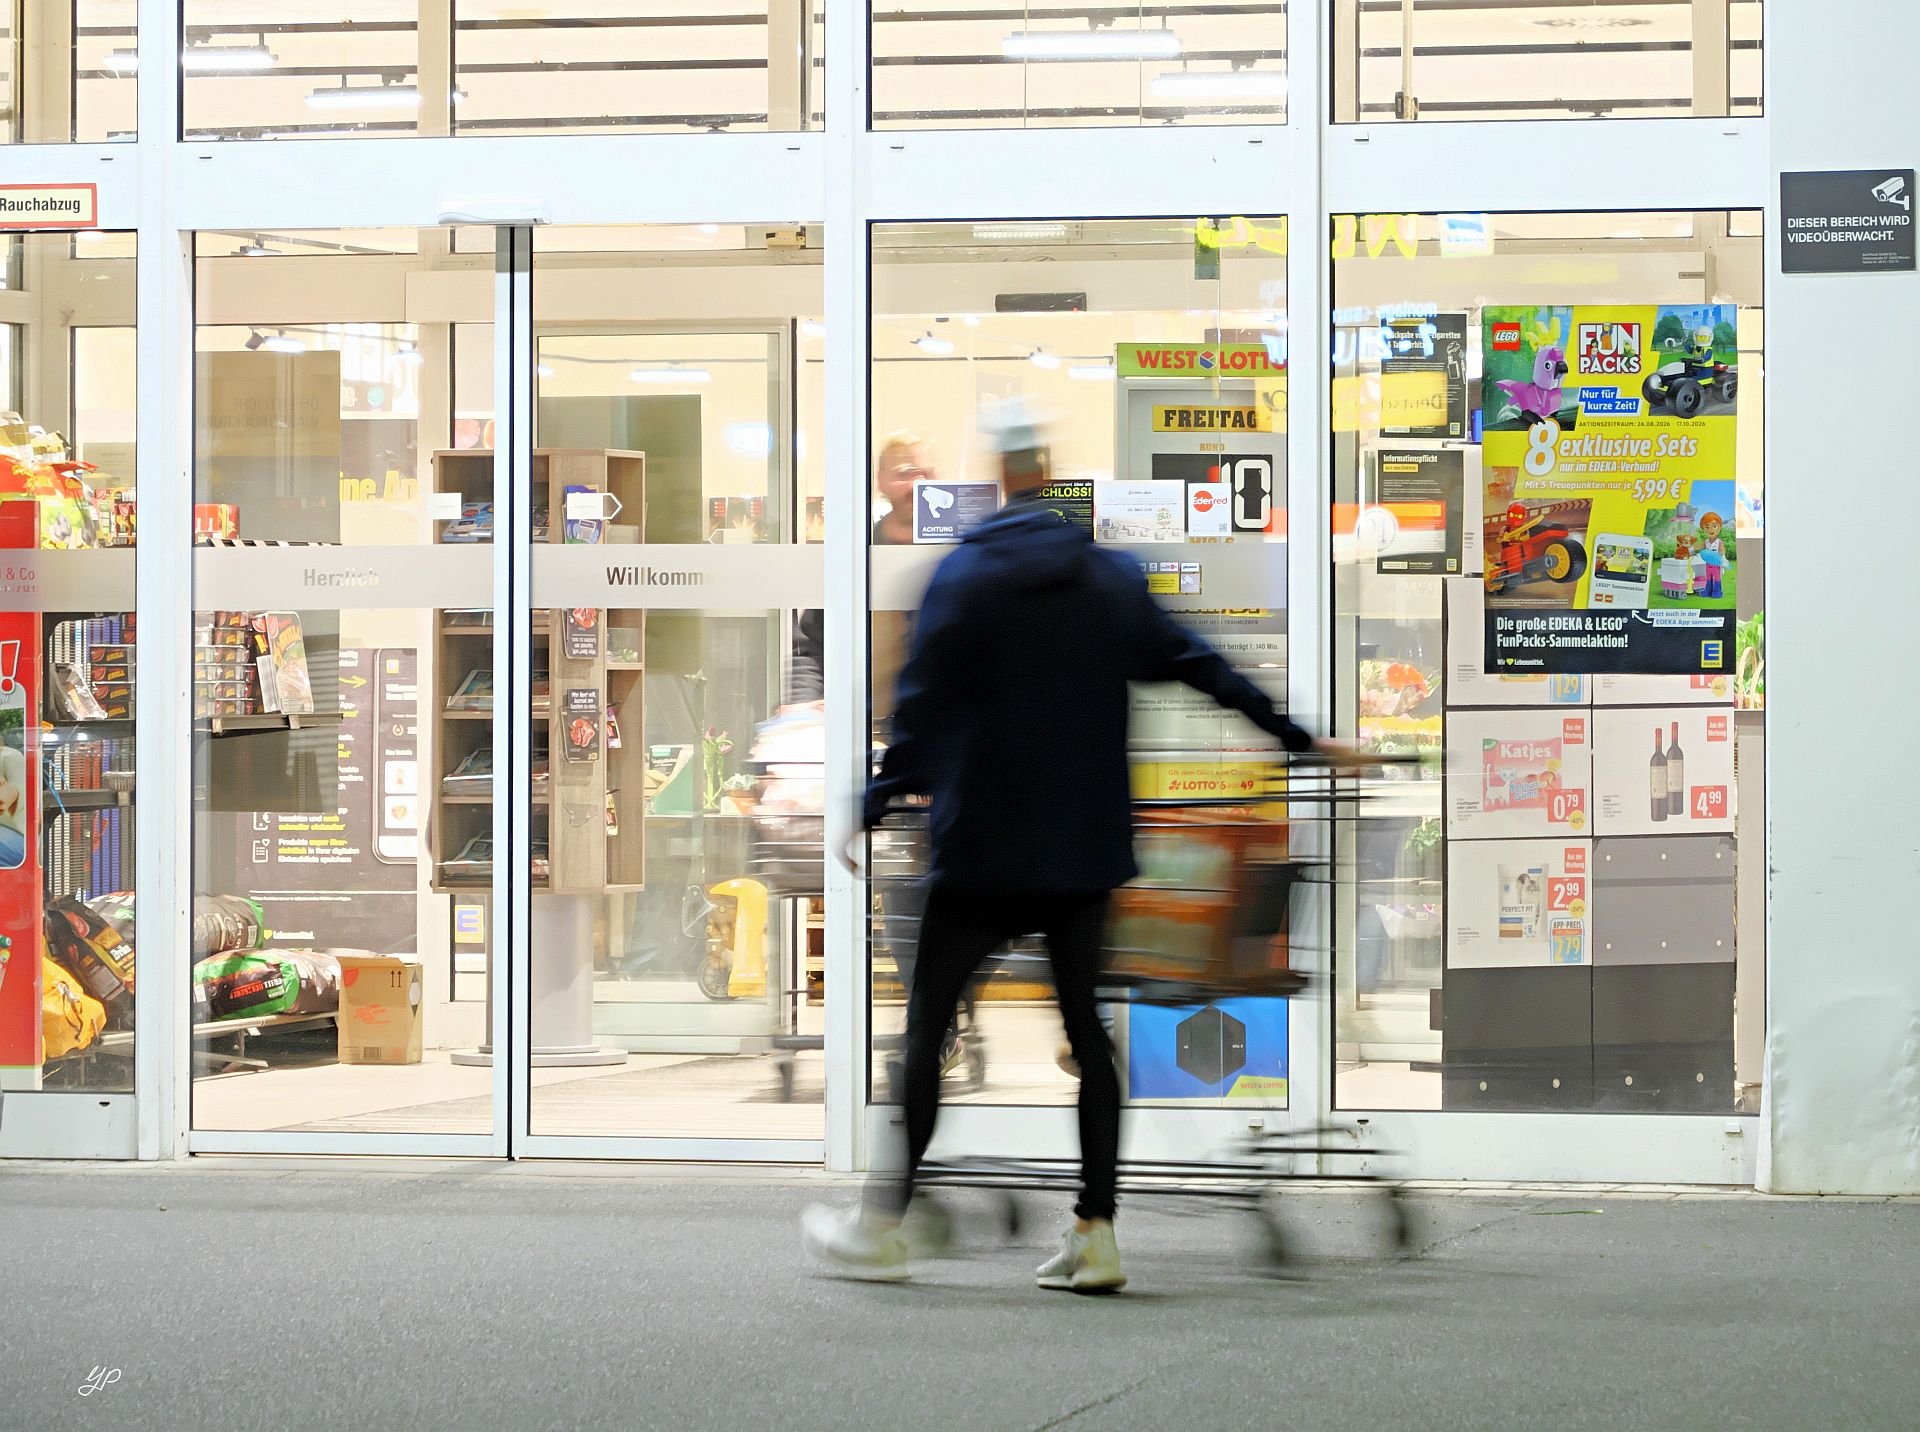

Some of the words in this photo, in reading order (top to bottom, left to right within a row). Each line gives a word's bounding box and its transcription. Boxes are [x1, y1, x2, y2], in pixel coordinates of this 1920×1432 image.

[0, 197, 80, 214] Rauchabzug
[1787, 217, 1828, 228] DIESER
[1830, 216, 1878, 227] BEREICH
[1879, 215, 1910, 226] WIRD
[1787, 230, 1895, 243] VIDEOÜBERWACHT.
[1495, 329, 1519, 343] LEGO
[1579, 323, 1639, 356] FUN
[1136, 350, 1197, 369] WEST
[1579, 356, 1641, 374] PACKS
[1582, 390, 1599, 400] Nur
[1601, 389, 1616, 400] für
[1587, 401, 1613, 411] kurze
[1615, 401, 1637, 411] Zeit!
[1164, 410, 1257, 428] FREITAG
[1524, 418, 1560, 476] 8
[1560, 434, 1651, 457] exklusive
[1655, 433, 1697, 457] Sets
[1383, 454, 1438, 464] Informationspflicht
[1559, 462, 1574, 472] nur
[1575, 461, 1586, 472] im
[1588, 460, 1660, 473] EDEKA-Verbund!
[1524, 480, 1539, 489] Mit
[1541, 480, 1547, 489] 5
[1549, 480, 1606, 490] Treuepunkten
[1623, 481, 1632, 491] je
[1632, 479, 1667, 501] 5,99
[1193, 496, 1228, 505] Edenred
[20, 566, 35, 581] Co
[304, 568, 379, 587] Herzlich
[1496, 617, 1514, 631] Die
[1516, 617, 1547, 633] große
[1549, 617, 1583, 631] EDEKA
[1584, 617, 1594, 631] &
[1228, 643, 1248, 652] beträgt
[1496, 633, 1628, 649] FunPacks-Sammelaktion!
[1500, 743, 1552, 761] Katjes
[1183, 780, 1216, 790] LOTTO
[1240, 780, 1254, 790] 49
[1553, 920, 1582, 930] APP-PREIS
